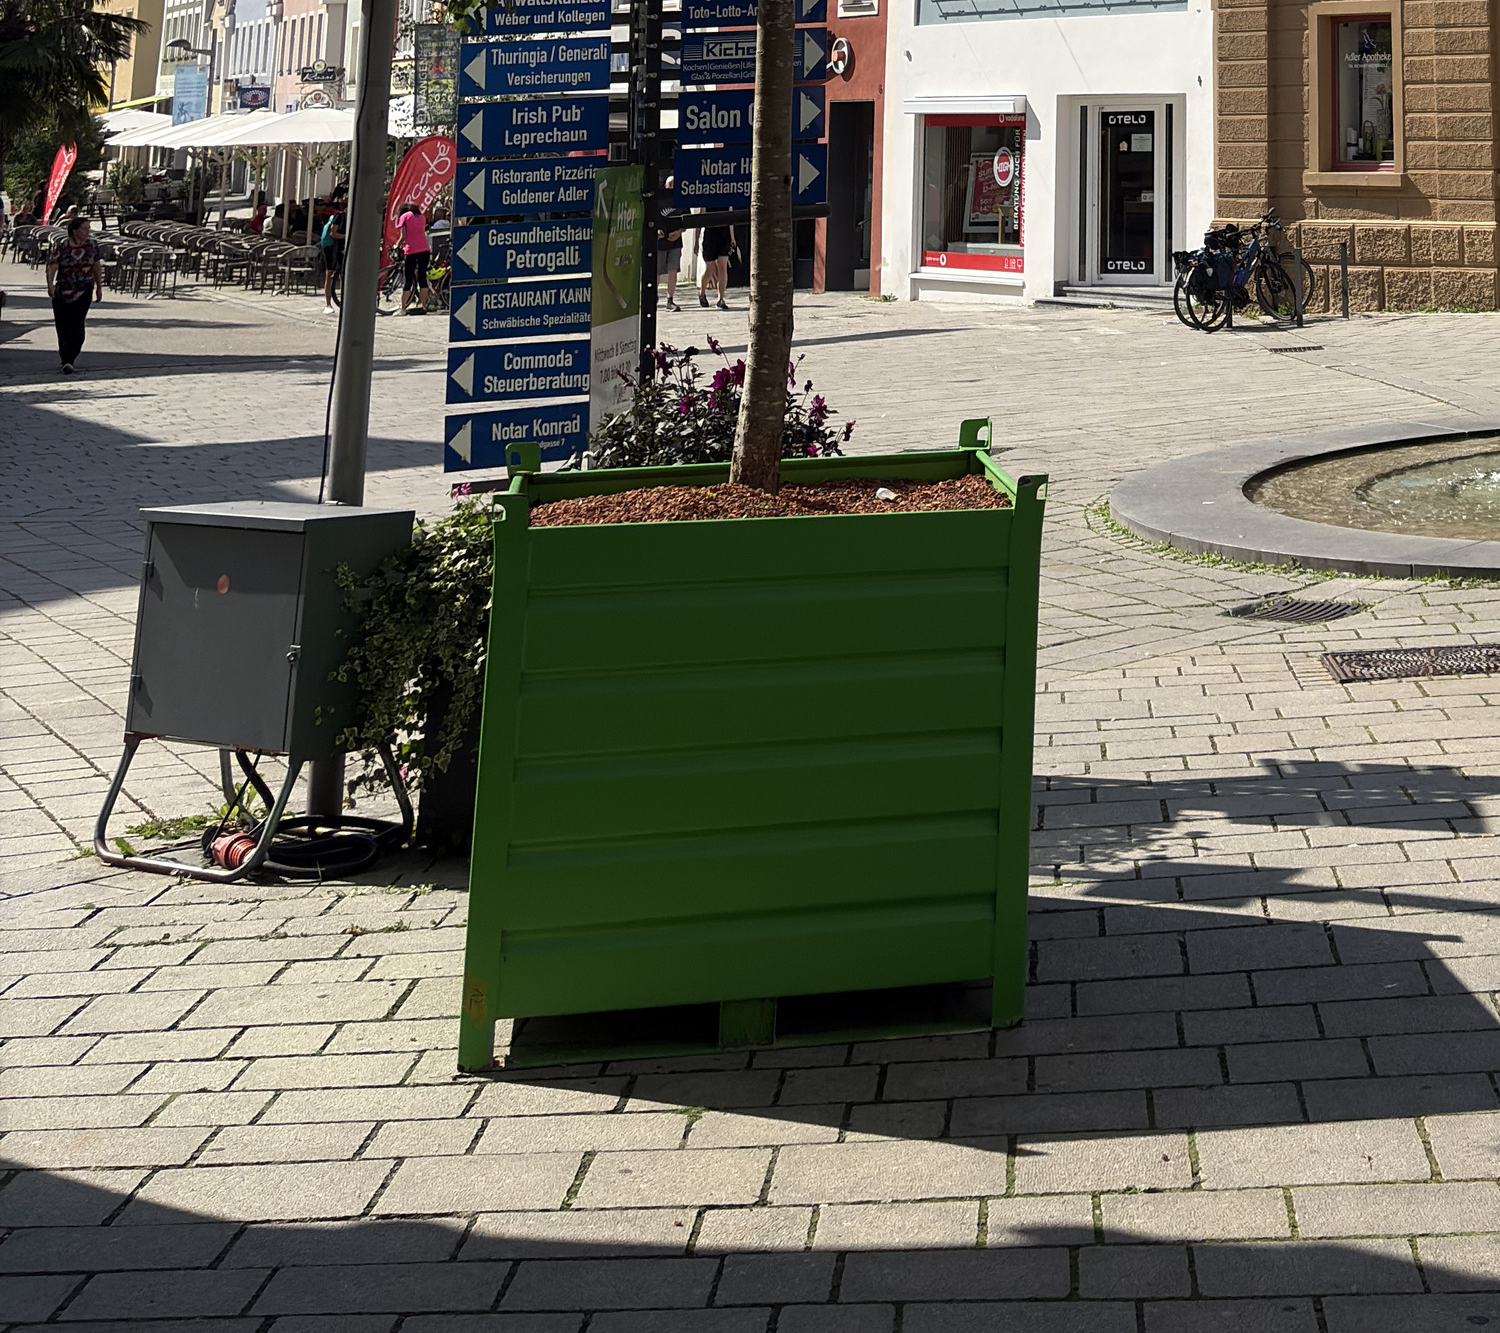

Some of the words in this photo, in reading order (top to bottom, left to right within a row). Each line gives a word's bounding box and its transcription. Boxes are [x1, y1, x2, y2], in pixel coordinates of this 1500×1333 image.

[494, 13, 531, 26] Weber
[533, 12, 555, 25] und
[557, 10, 606, 25] Kollegen
[490, 46, 548, 68] Thuringia
[550, 45, 556, 63] /
[558, 43, 608, 62] Generali
[1362, 51, 1391, 63] Apotheke
[507, 70, 591, 86] Versicherungen
[512, 106, 547, 125] Irish
[552, 104, 581, 123] Pub
[686, 104, 741, 130] Salon
[504, 127, 588, 149] Leprechaun
[491, 167, 551, 185] Ristorante
[701, 159, 737, 176] Notar
[502, 189, 555, 205] Goldener
[557, 186, 589, 202] Adler
[506, 245, 580, 272] Petrogalli
[482, 289, 557, 310] RESTAURANT
[482, 315, 540, 330] Schwäbische
[504, 349, 573, 371] Commoda
[483, 372, 590, 393] Steuerberatung
[491, 422, 529, 442] Notar
[533, 414, 580, 438] Konrad
